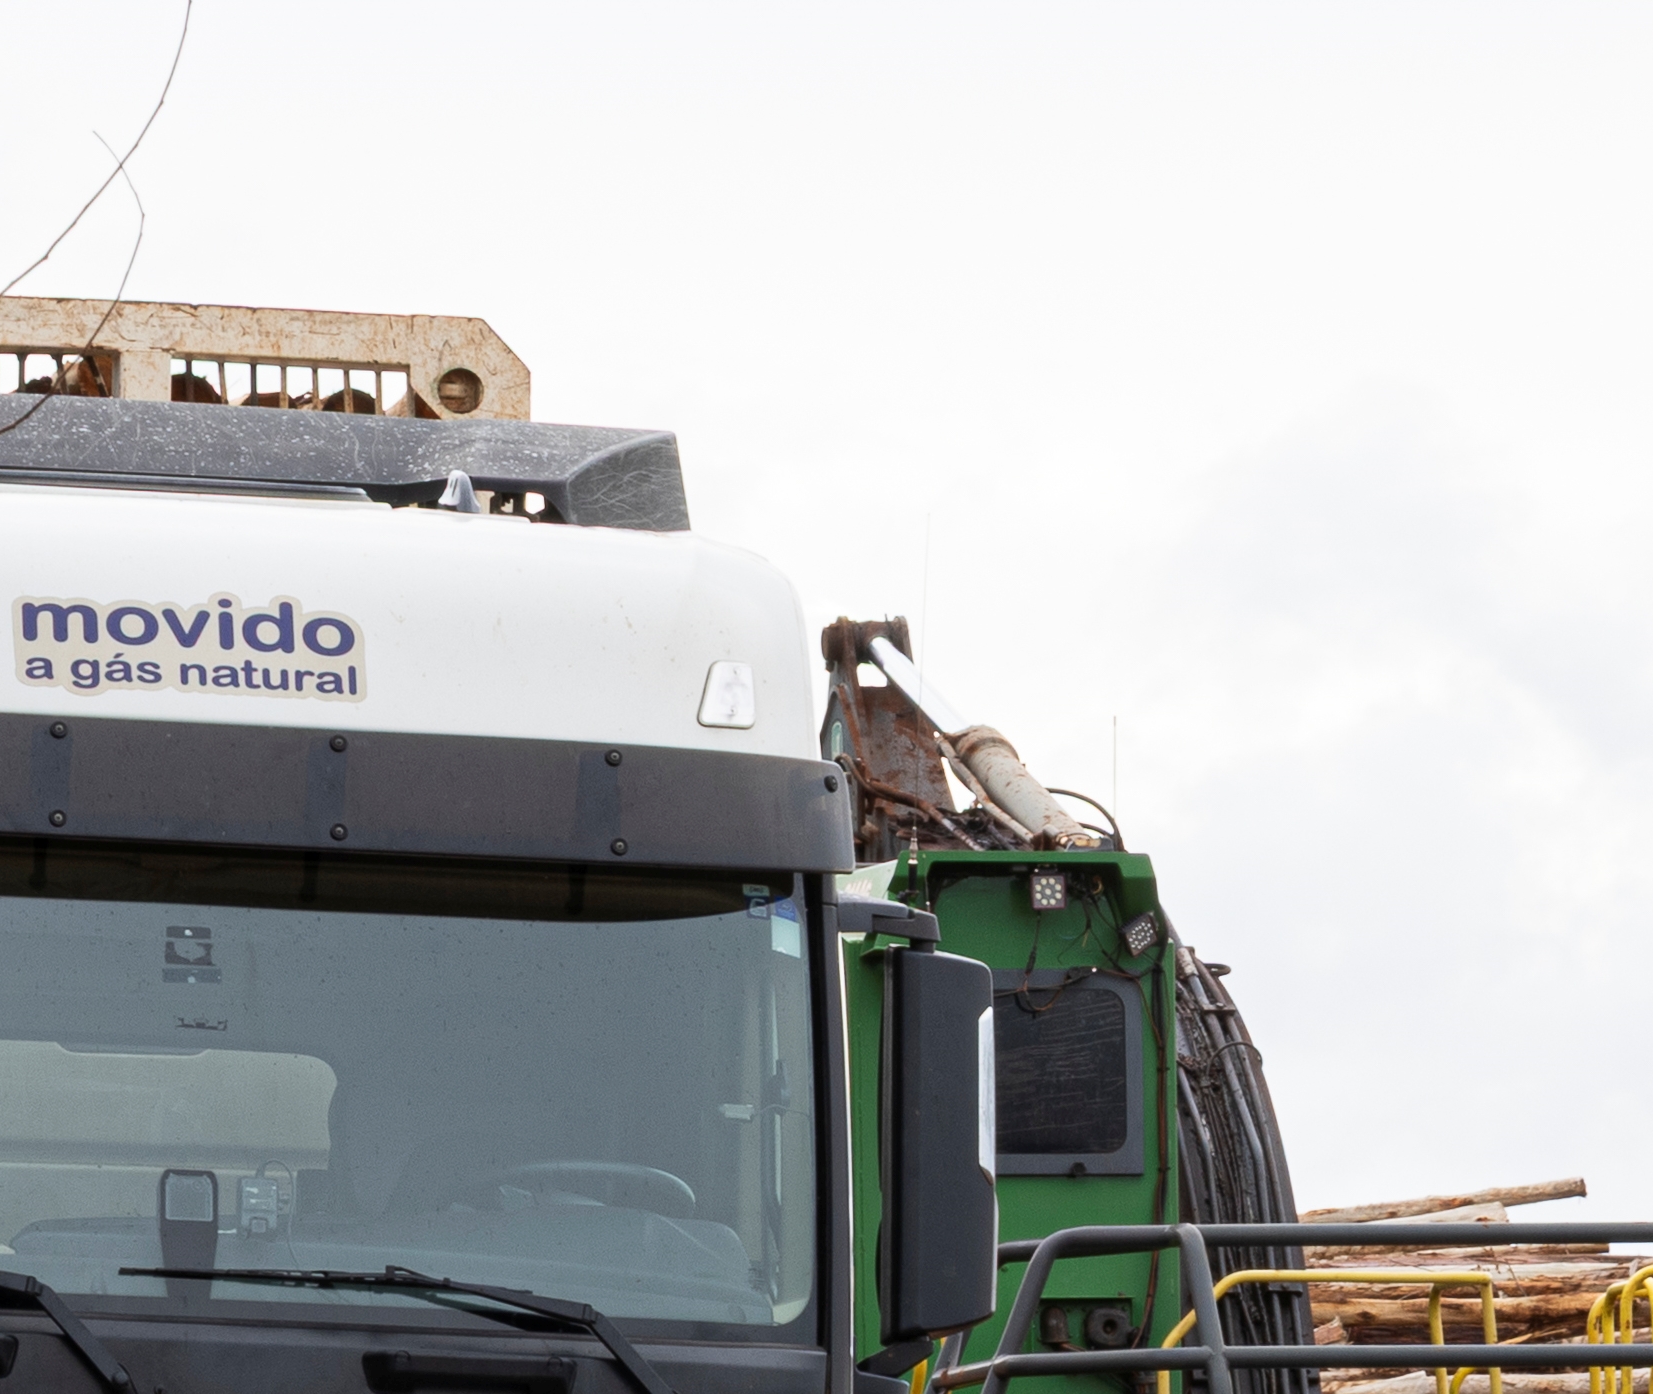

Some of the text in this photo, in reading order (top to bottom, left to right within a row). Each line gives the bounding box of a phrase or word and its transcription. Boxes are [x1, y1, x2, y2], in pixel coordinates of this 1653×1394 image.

[21, 598, 356, 657] movido
[25, 652, 358, 696] a gás natural
